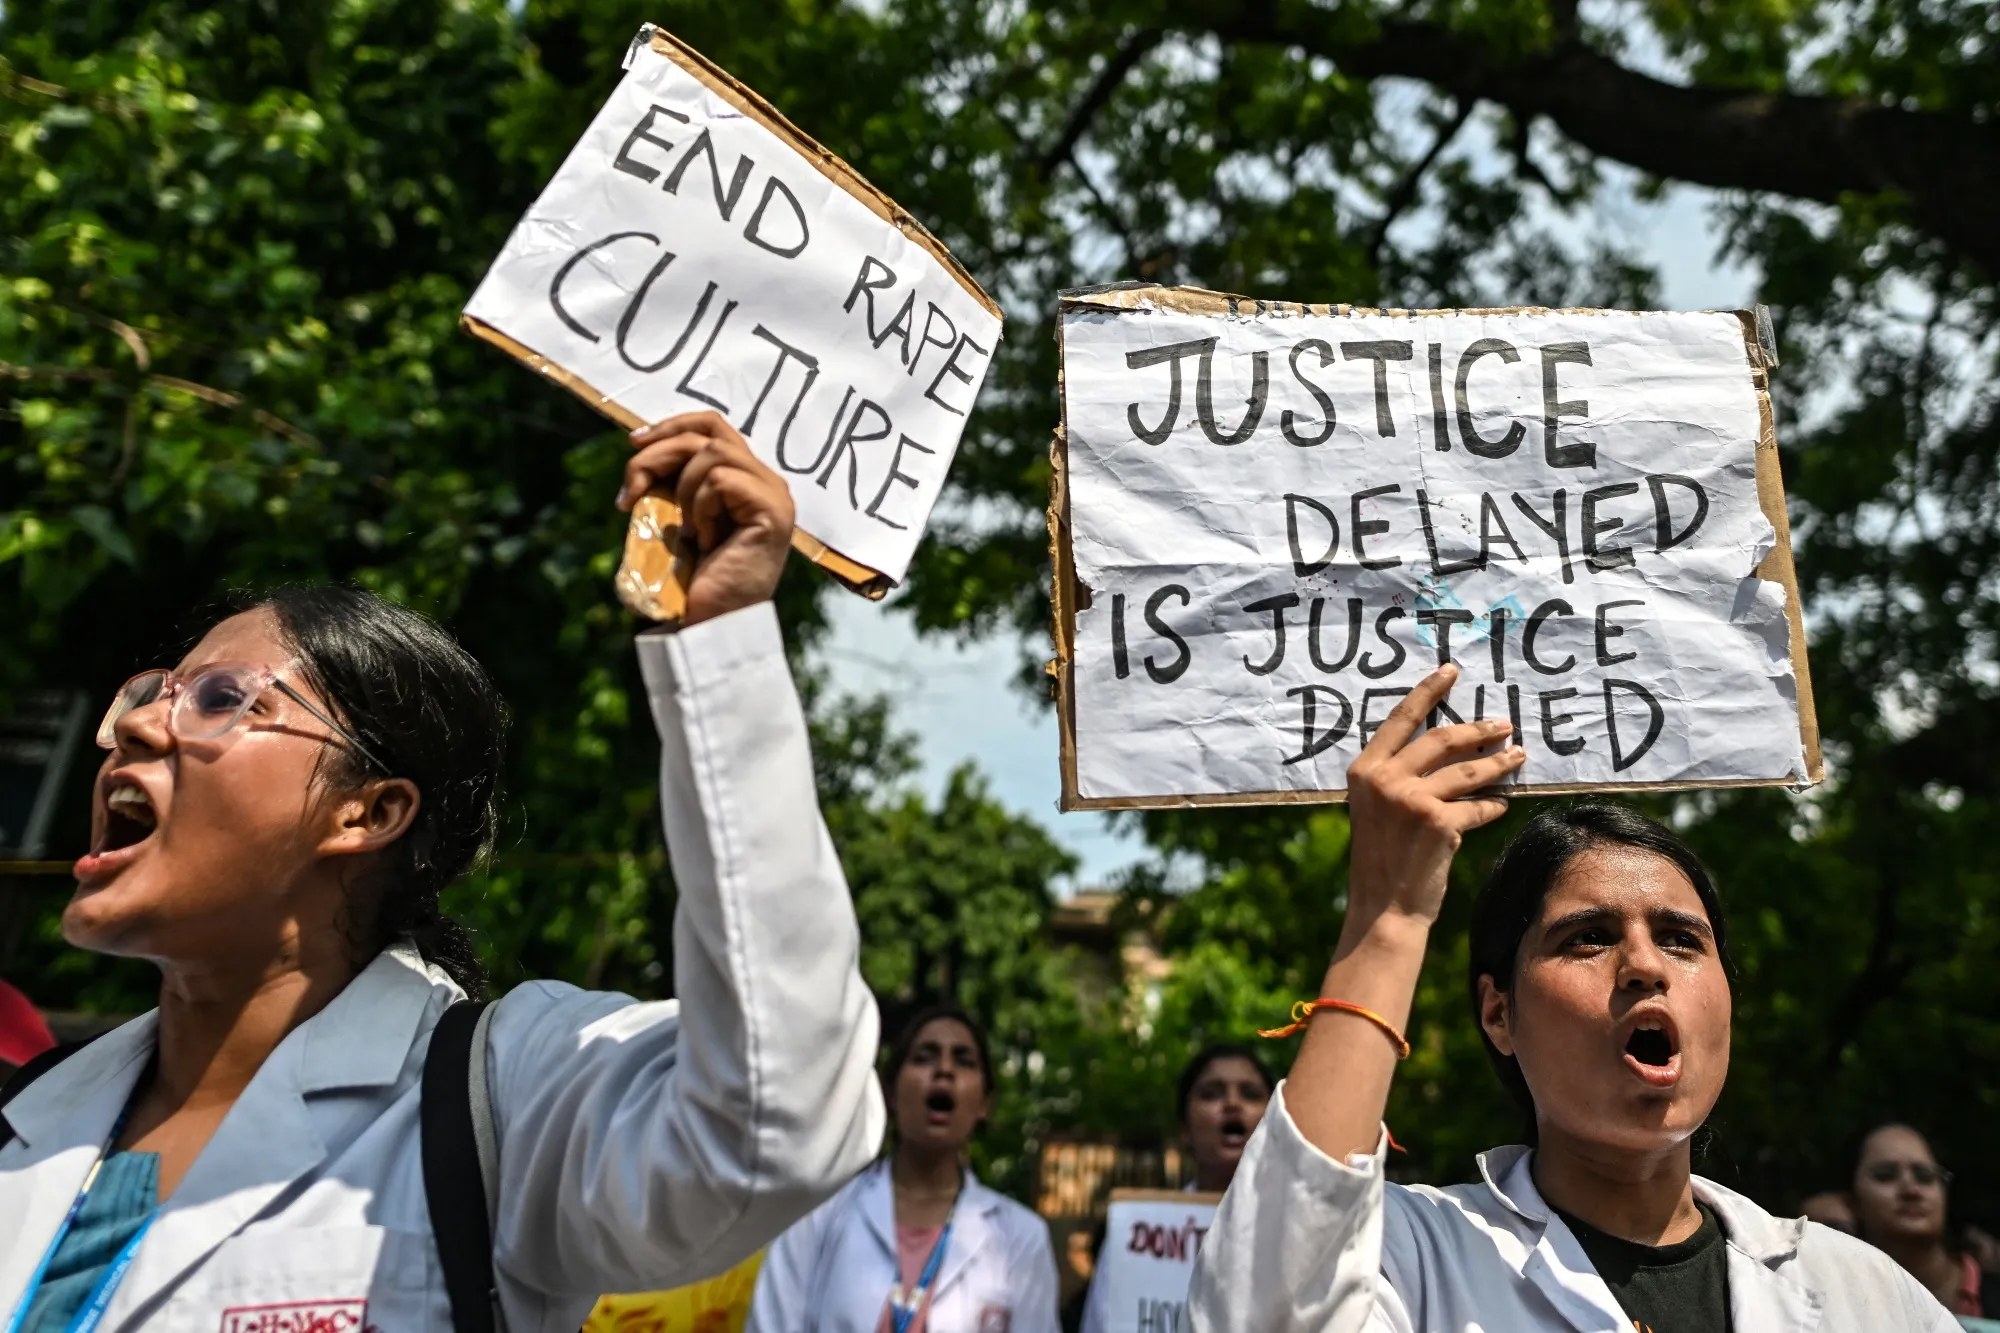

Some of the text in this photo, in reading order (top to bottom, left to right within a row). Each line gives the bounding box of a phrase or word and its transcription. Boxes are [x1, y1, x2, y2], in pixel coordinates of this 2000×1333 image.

[613, 103, 989, 417] END RAPE
[550, 231, 935, 531] CULTURE
[1125, 336, 1597, 469] JUSTICE
[1282, 474, 1709, 584] DELAYED
[1112, 584, 1645, 684] IS JUSTICE
